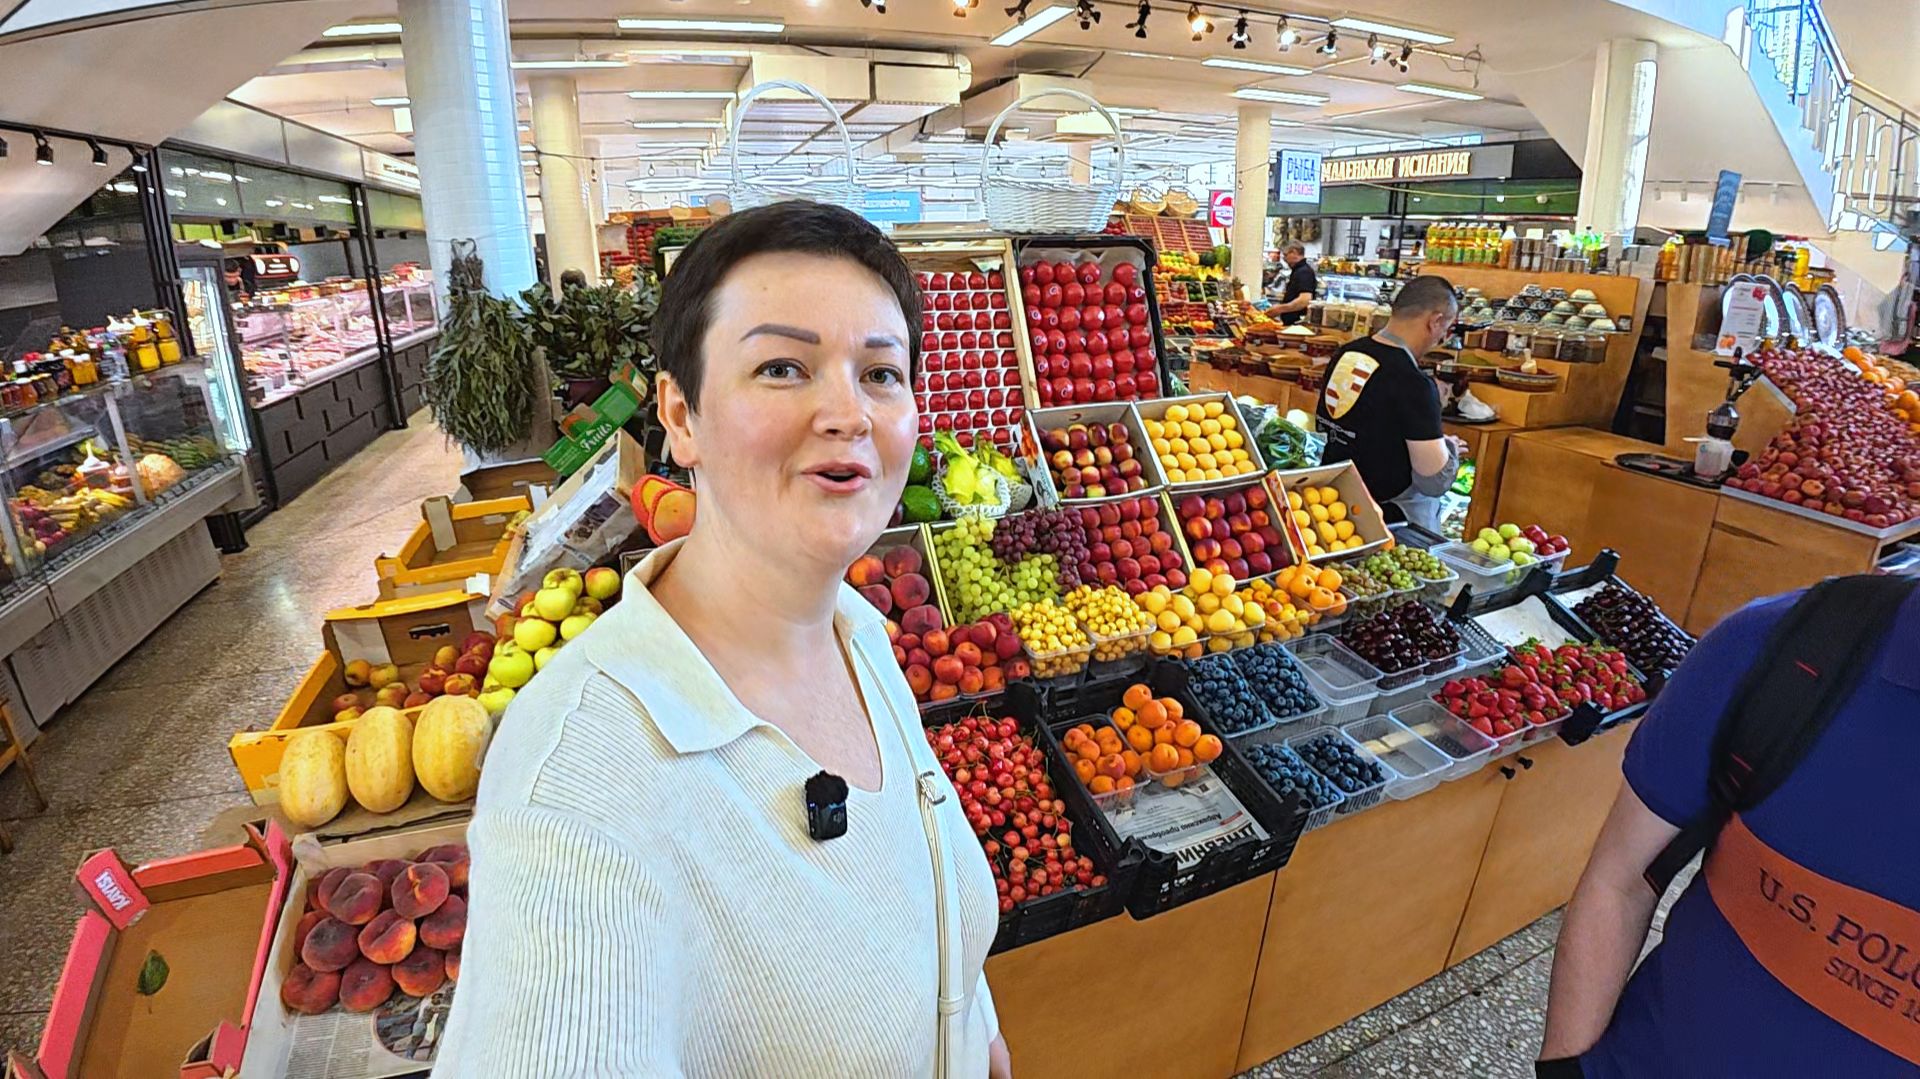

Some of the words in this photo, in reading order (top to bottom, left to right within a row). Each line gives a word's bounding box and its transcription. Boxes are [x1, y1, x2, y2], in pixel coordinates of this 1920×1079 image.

[1286, 157, 1315, 181] РЫБА
[1321, 158, 1395, 182] МАЛЕНЬКАЯ
[1399, 152, 1471, 178] ИСПАНИЯ
[1759, 867, 1817, 932] U.S.
[1824, 956, 1900, 1010] SINCE
